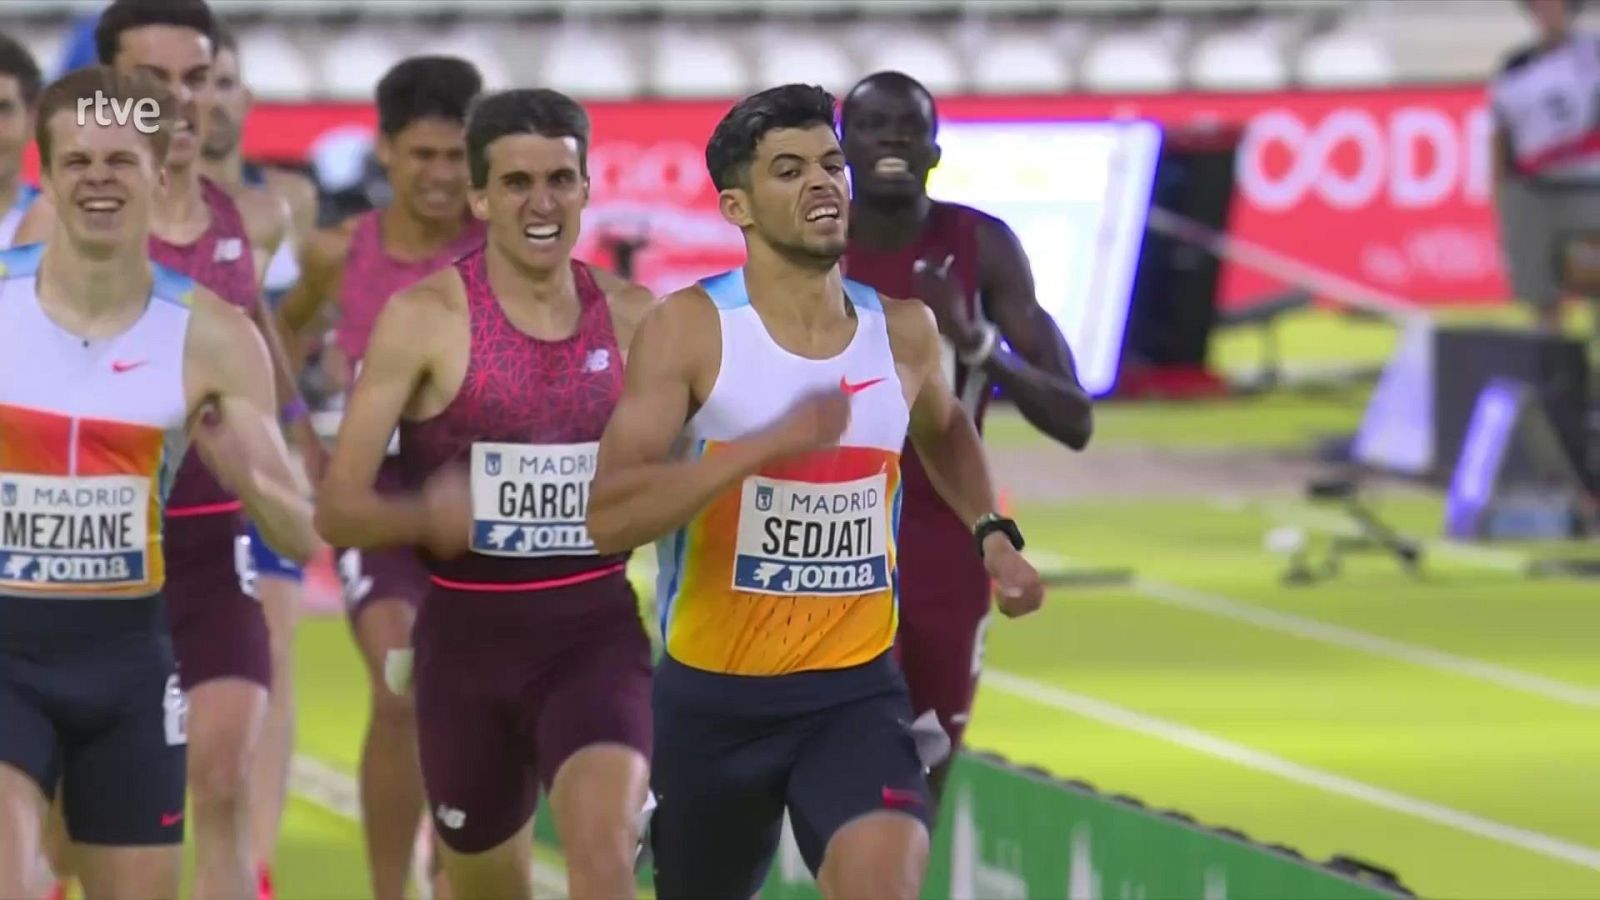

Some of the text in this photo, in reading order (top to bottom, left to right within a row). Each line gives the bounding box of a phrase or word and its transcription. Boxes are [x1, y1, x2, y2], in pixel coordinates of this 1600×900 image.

[34, 486, 136, 508] MADRID
[499, 481, 584, 519] GARCI
[790, 488, 878, 515] MADRID
[3, 511, 133, 549] MEZIANE
[762, 516, 872, 559] SEDJATI
